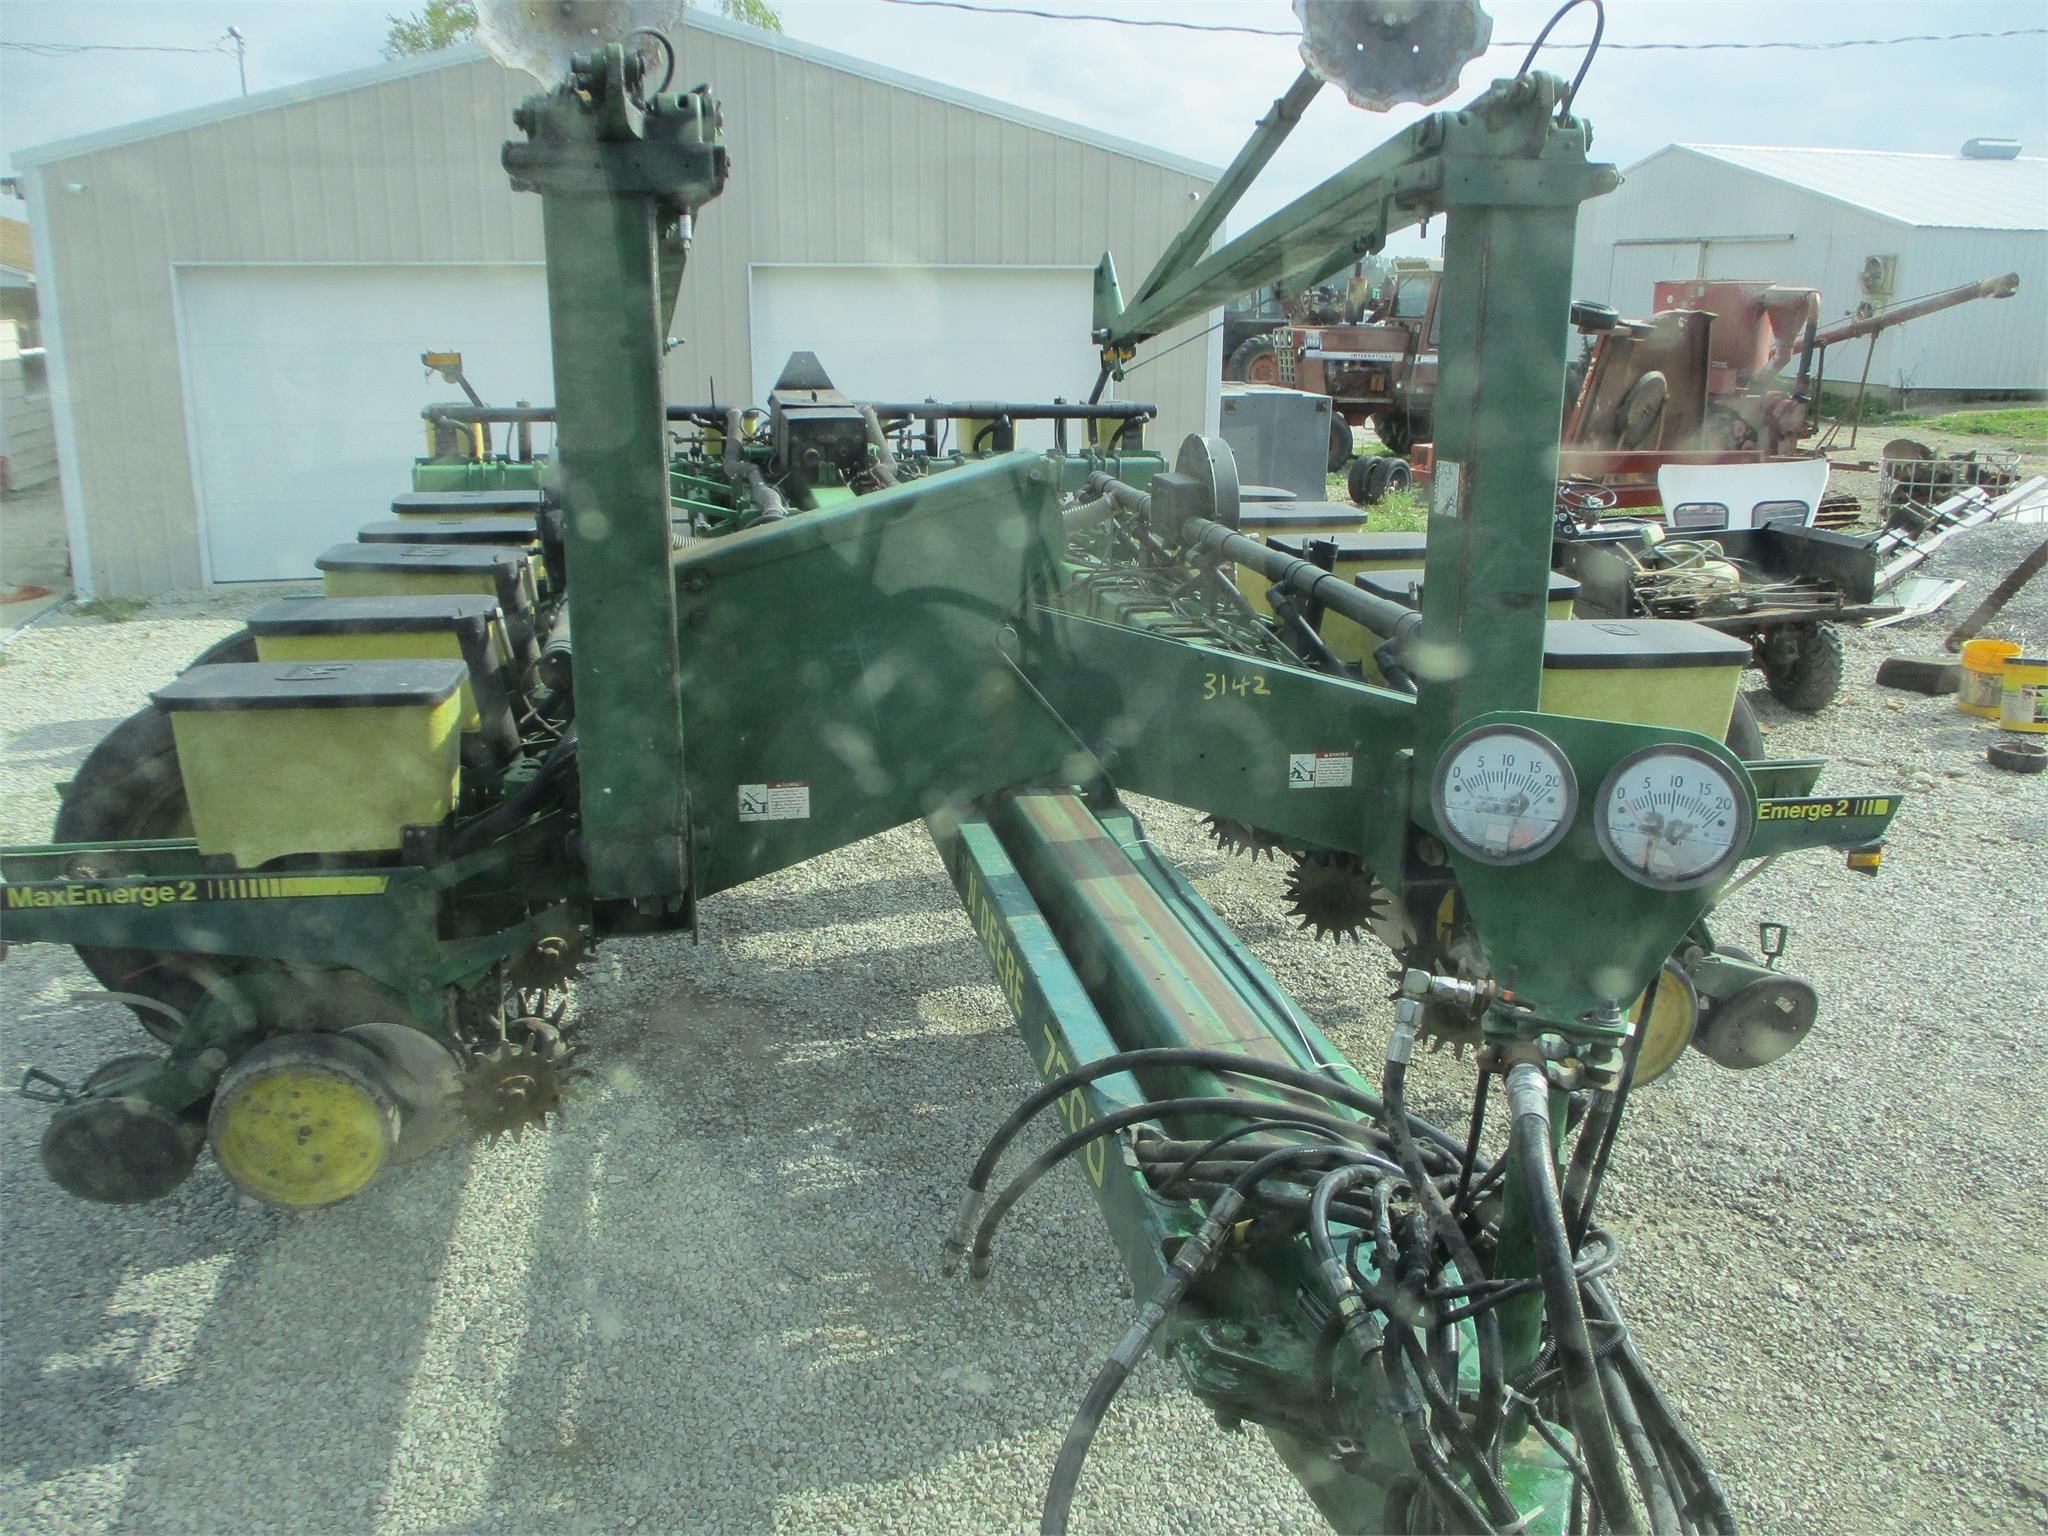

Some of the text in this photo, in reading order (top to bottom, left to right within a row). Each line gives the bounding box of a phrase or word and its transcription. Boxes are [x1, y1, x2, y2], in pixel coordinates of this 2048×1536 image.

[1351, 352, 1396, 360] INTERNATIONA
[1203, 673, 1271, 700] 3142
[1477, 756, 1485, 768] 5
[1502, 754, 1515, 766] 10
[1530, 760, 1542, 774] 15
[1453, 766, 1461, 778] 0
[1545, 774, 1560, 788] 20
[1643, 776, 1651, 789] 5
[1670, 775, 1684, 788] 10
[1617, 787, 1626, 799] 0
[1699, 782, 1712, 796] 15
[1715, 796, 1732, 810] 20
[1757, 799, 1849, 822] Emerge 2
[7, 881, 198, 908] MaxEmerge 2
[980, 896, 1025, 1020] DEERE
